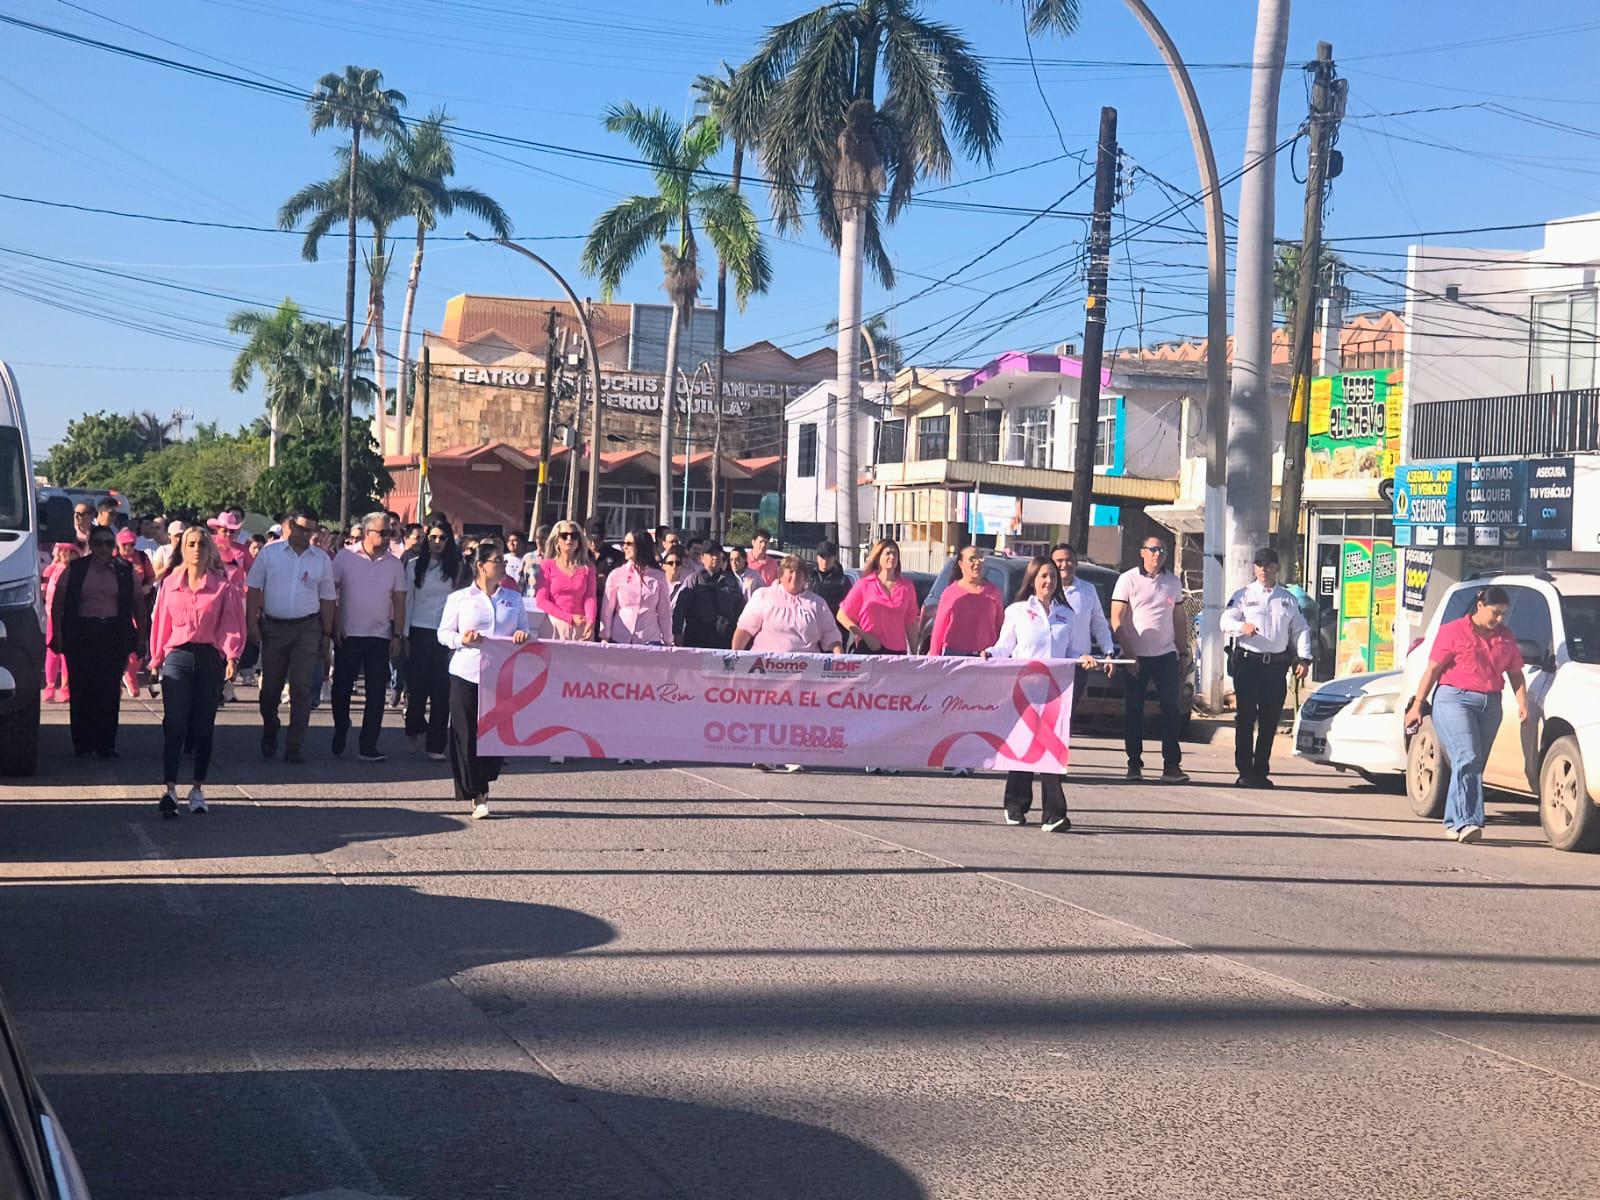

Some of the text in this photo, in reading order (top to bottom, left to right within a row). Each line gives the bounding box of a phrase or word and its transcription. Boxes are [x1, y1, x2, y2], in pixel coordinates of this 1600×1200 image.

[452, 367, 530, 386] TEATRO
[1465, 467, 1513, 481] MEJORAMOS
[1536, 466, 1566, 478] ASEGURA
[1466, 489, 1511, 502] CUALQUIER
[1529, 483, 1572, 498] TU VEHÍCULO
[1411, 498, 1447, 522] SEGUROS
[1542, 508, 1557, 518] CON
[1406, 549, 1433, 565] SEGUROS
[748, 657, 808, 674] Ahome
[561, 681, 656, 701] MARCHA
[656, 683, 697, 704] Rosa
[704, 687, 794, 706] CONTRA
[799, 691, 820, 707] EL
[826, 687, 913, 712] CÁNCER
[912, 693, 932, 712] de
[704, 721, 846, 747] OCTUBRE
